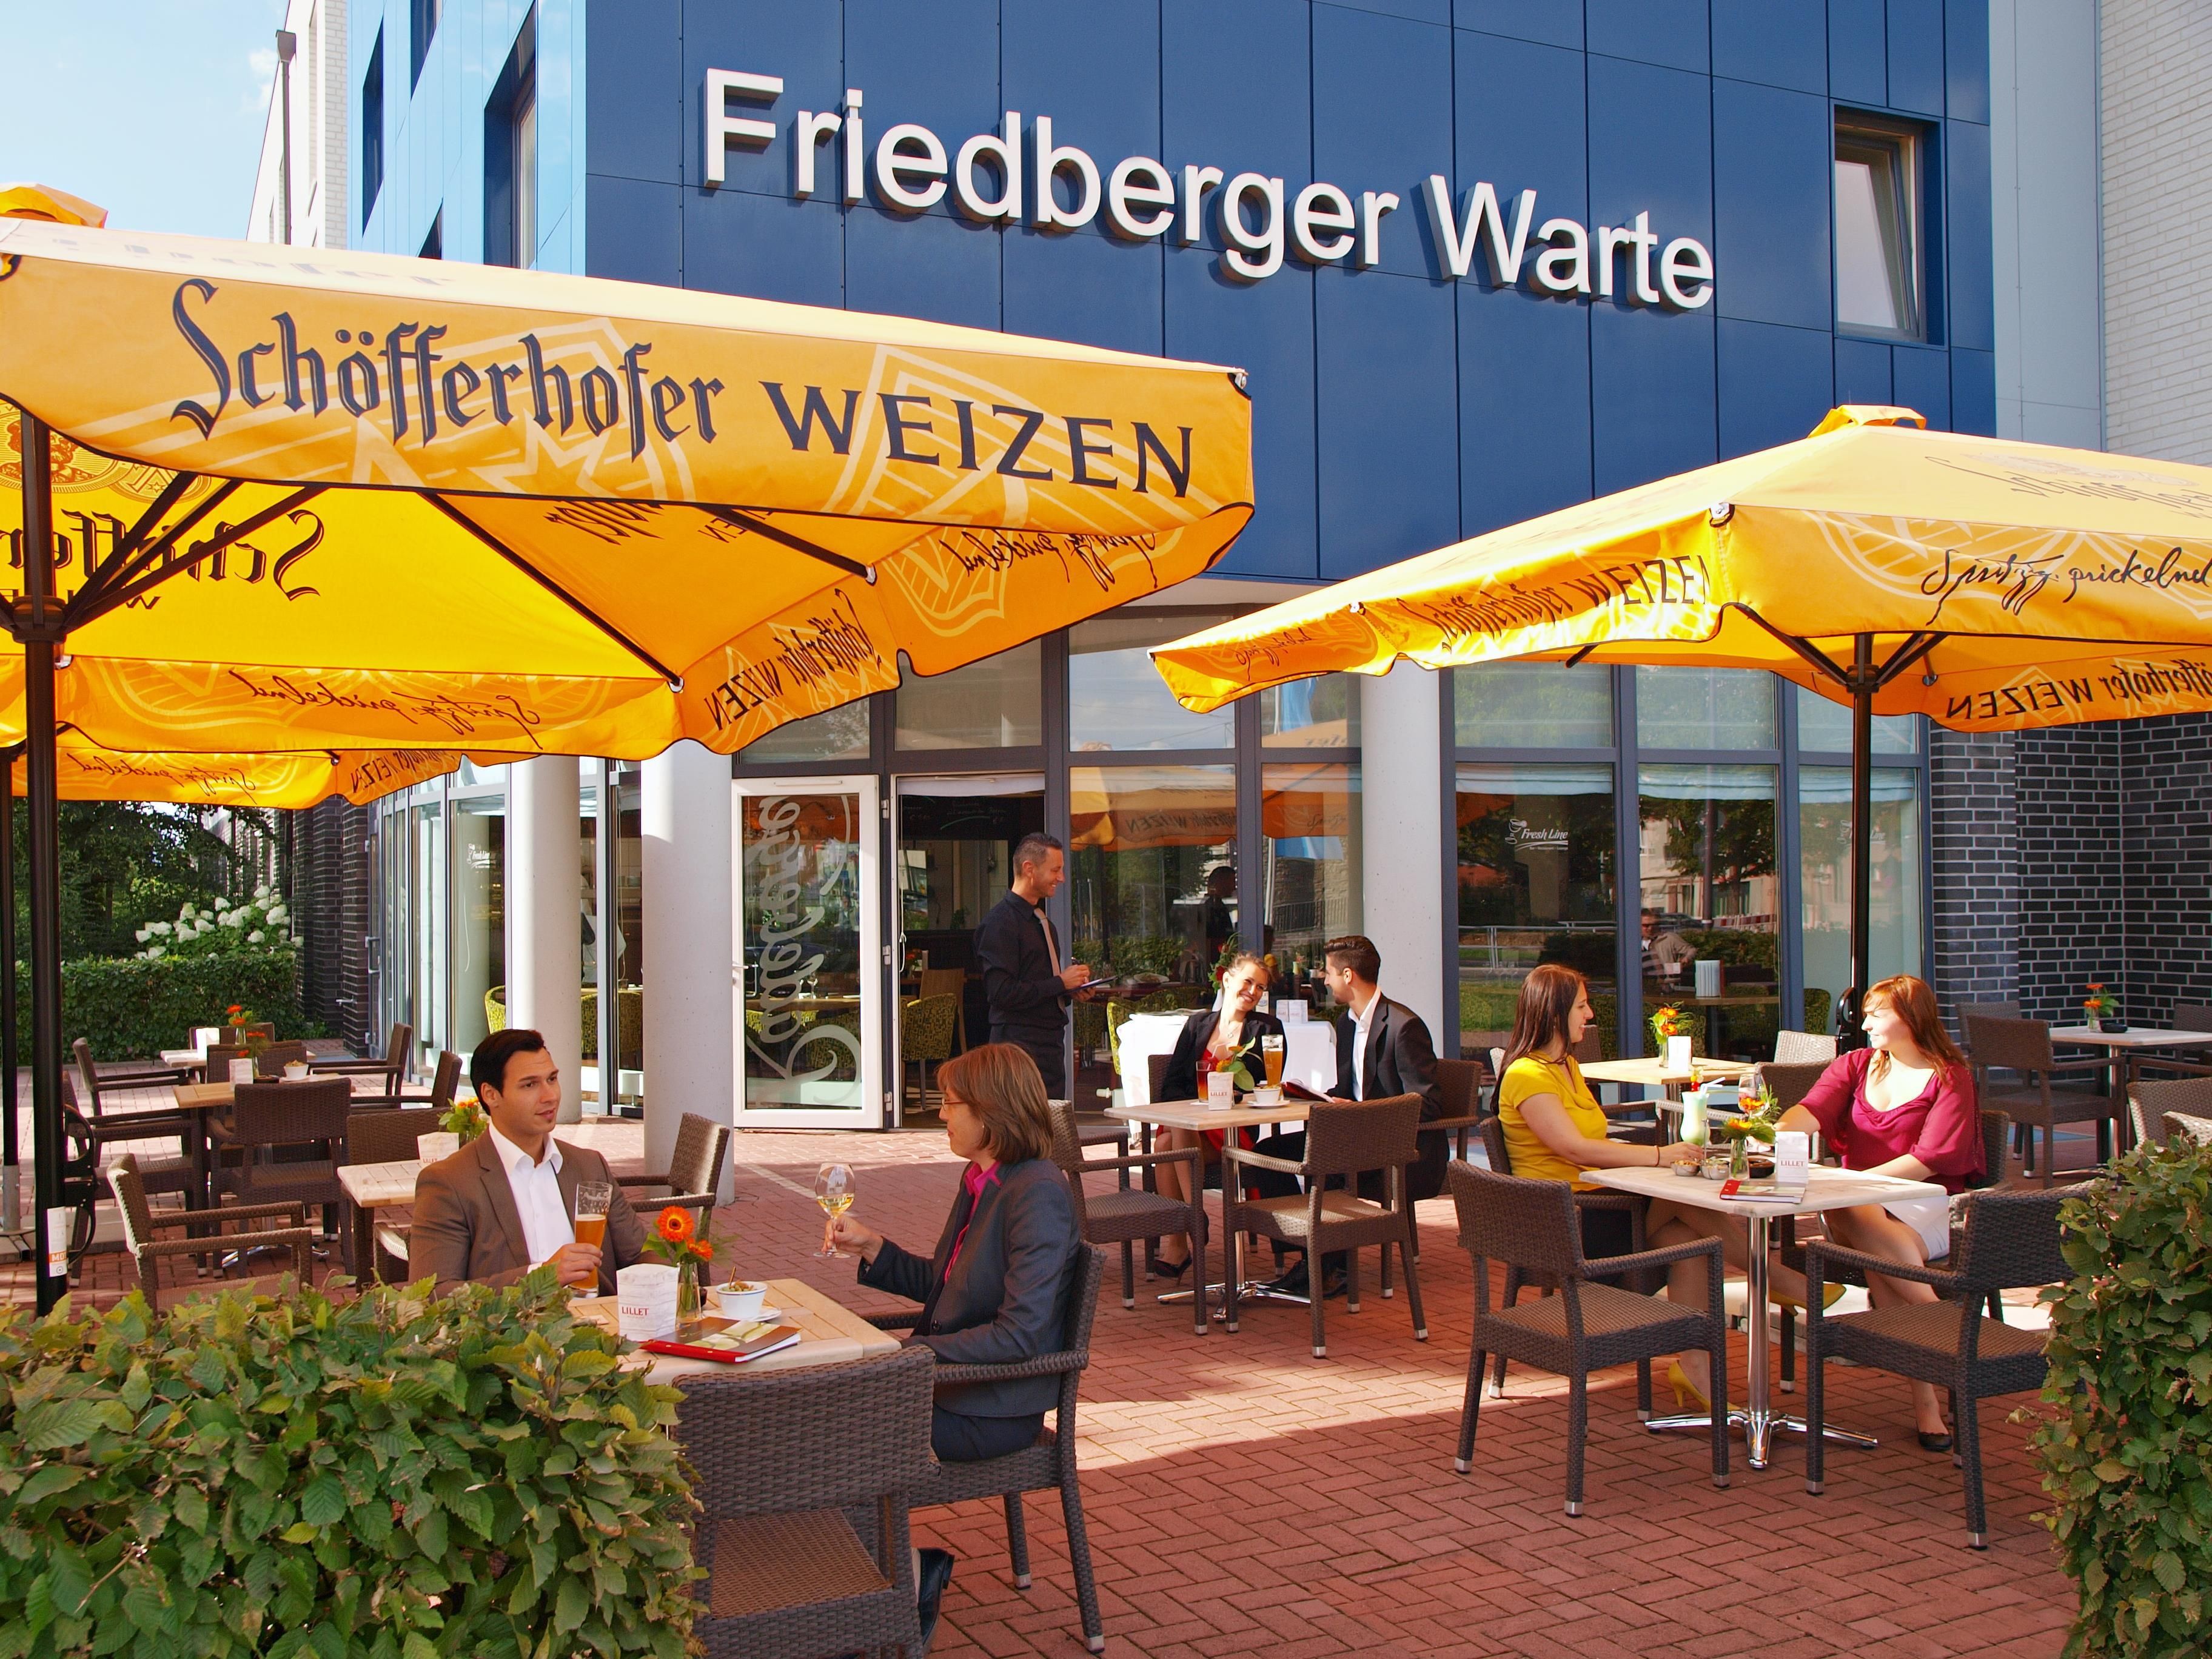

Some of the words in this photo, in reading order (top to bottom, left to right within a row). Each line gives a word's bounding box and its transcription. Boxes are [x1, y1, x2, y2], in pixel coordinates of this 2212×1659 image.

[702, 68, 1399, 281] Friedberger
[1425, 173, 1715, 310] Warte
[170, 278, 725, 463] Schöfferhofer
[760, 381, 1193, 497] WEIZEN
[1520, 828, 1547, 840] Fresh
[1547, 828, 1569, 840] Line
[622, 1306, 649, 1316] LILLET
